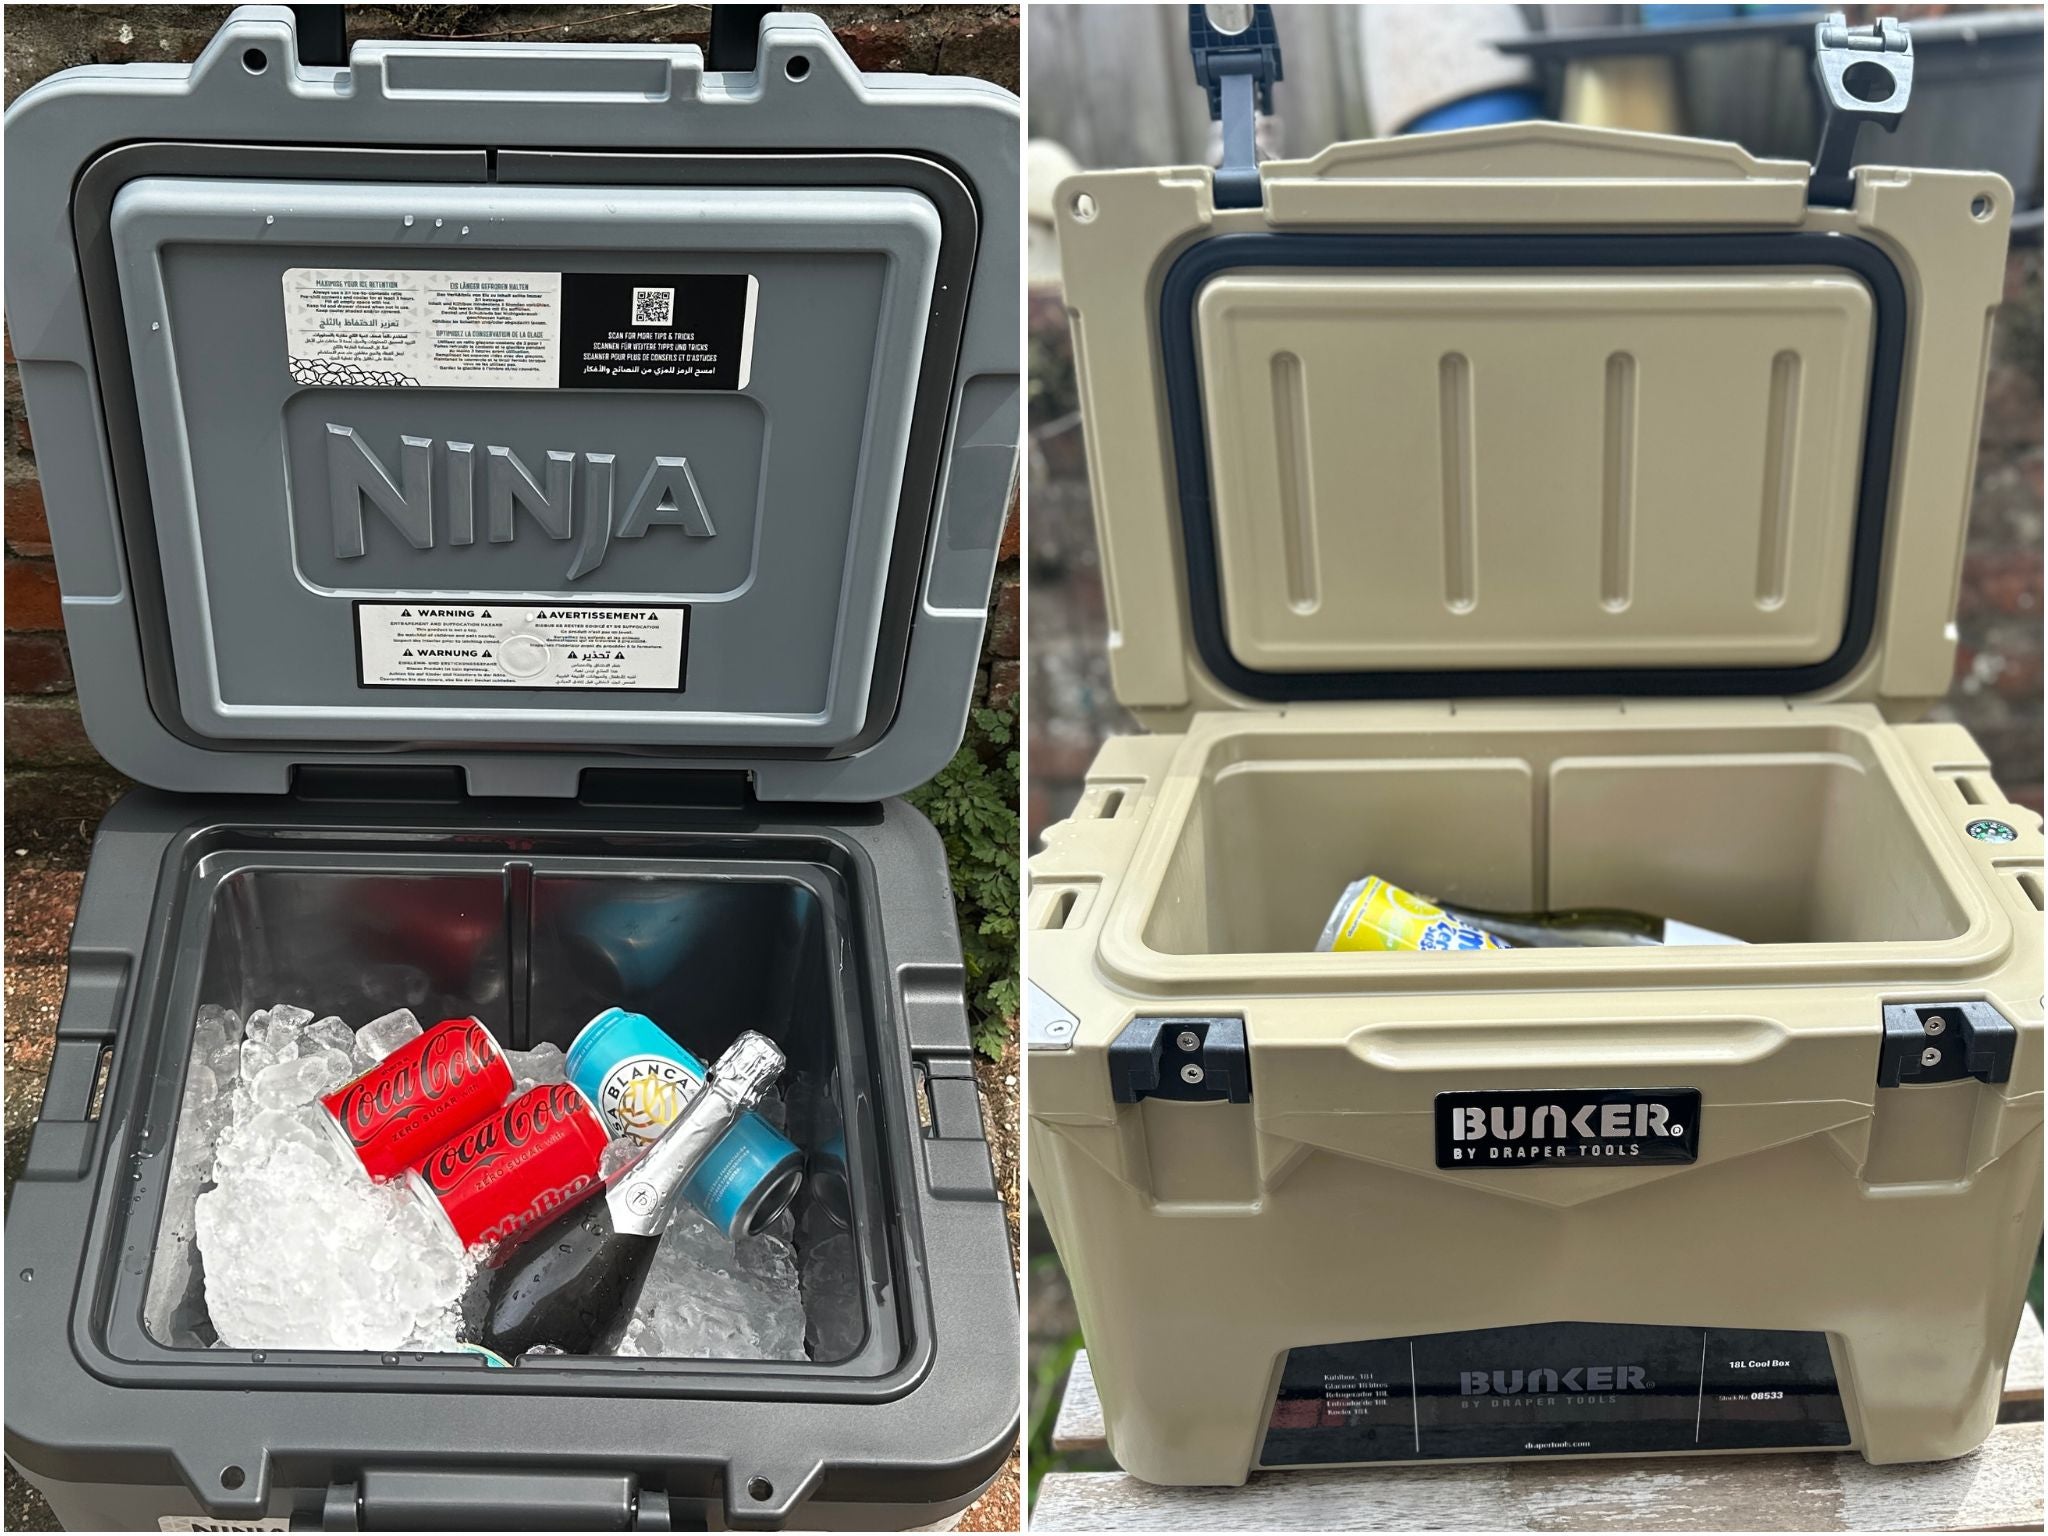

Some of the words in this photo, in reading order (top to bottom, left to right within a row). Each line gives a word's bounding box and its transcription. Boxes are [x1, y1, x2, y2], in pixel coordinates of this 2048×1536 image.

[319, 318, 341, 329] بالثلج
[608, 332, 623, 340] SCAN
[625, 332, 636, 340] FOR
[637, 332, 653, 340] MORE
[621, 342, 632, 350] FÜR
[658, 343, 673, 351] TIPPS
[610, 353, 626, 361] POUR
[627, 353, 641, 361] PLUS
[326, 423, 717, 580] NINJA
[418, 609, 475, 618] WARNING
[549, 611, 646, 620] AVERTISSEMENT
[418, 649, 478, 658] WARNUNG
[582, 651, 611, 661] تحذير
[339, 1023, 496, 1147] Coca-Cola
[607, 1064, 689, 1099] BLANCA
[391, 1121, 419, 1142] ZERO
[422, 1096, 456, 1122] SUGAR
[422, 1083, 585, 1196] Coca-Cola
[1453, 1148, 1476, 1160] BY
[1490, 1146, 1567, 1159] DRAPER
[1579, 1144, 1640, 1157] TOOLS
[475, 1168, 504, 1190] ZERO
[507, 1143, 543, 1170] SUGAR
[1729, 1361, 1747, 1369] 18L
[1748, 1360, 1770, 1368] Cool
[1751, 1391, 1783, 1400] 08533
[1461, 1400, 1480, 1408] BY
[1491, 1397, 1555, 1408] DRAPER
[1566, 1395, 1617, 1406] TOOLS
[1525, 1441, 1591, 1450] drapertools.com
